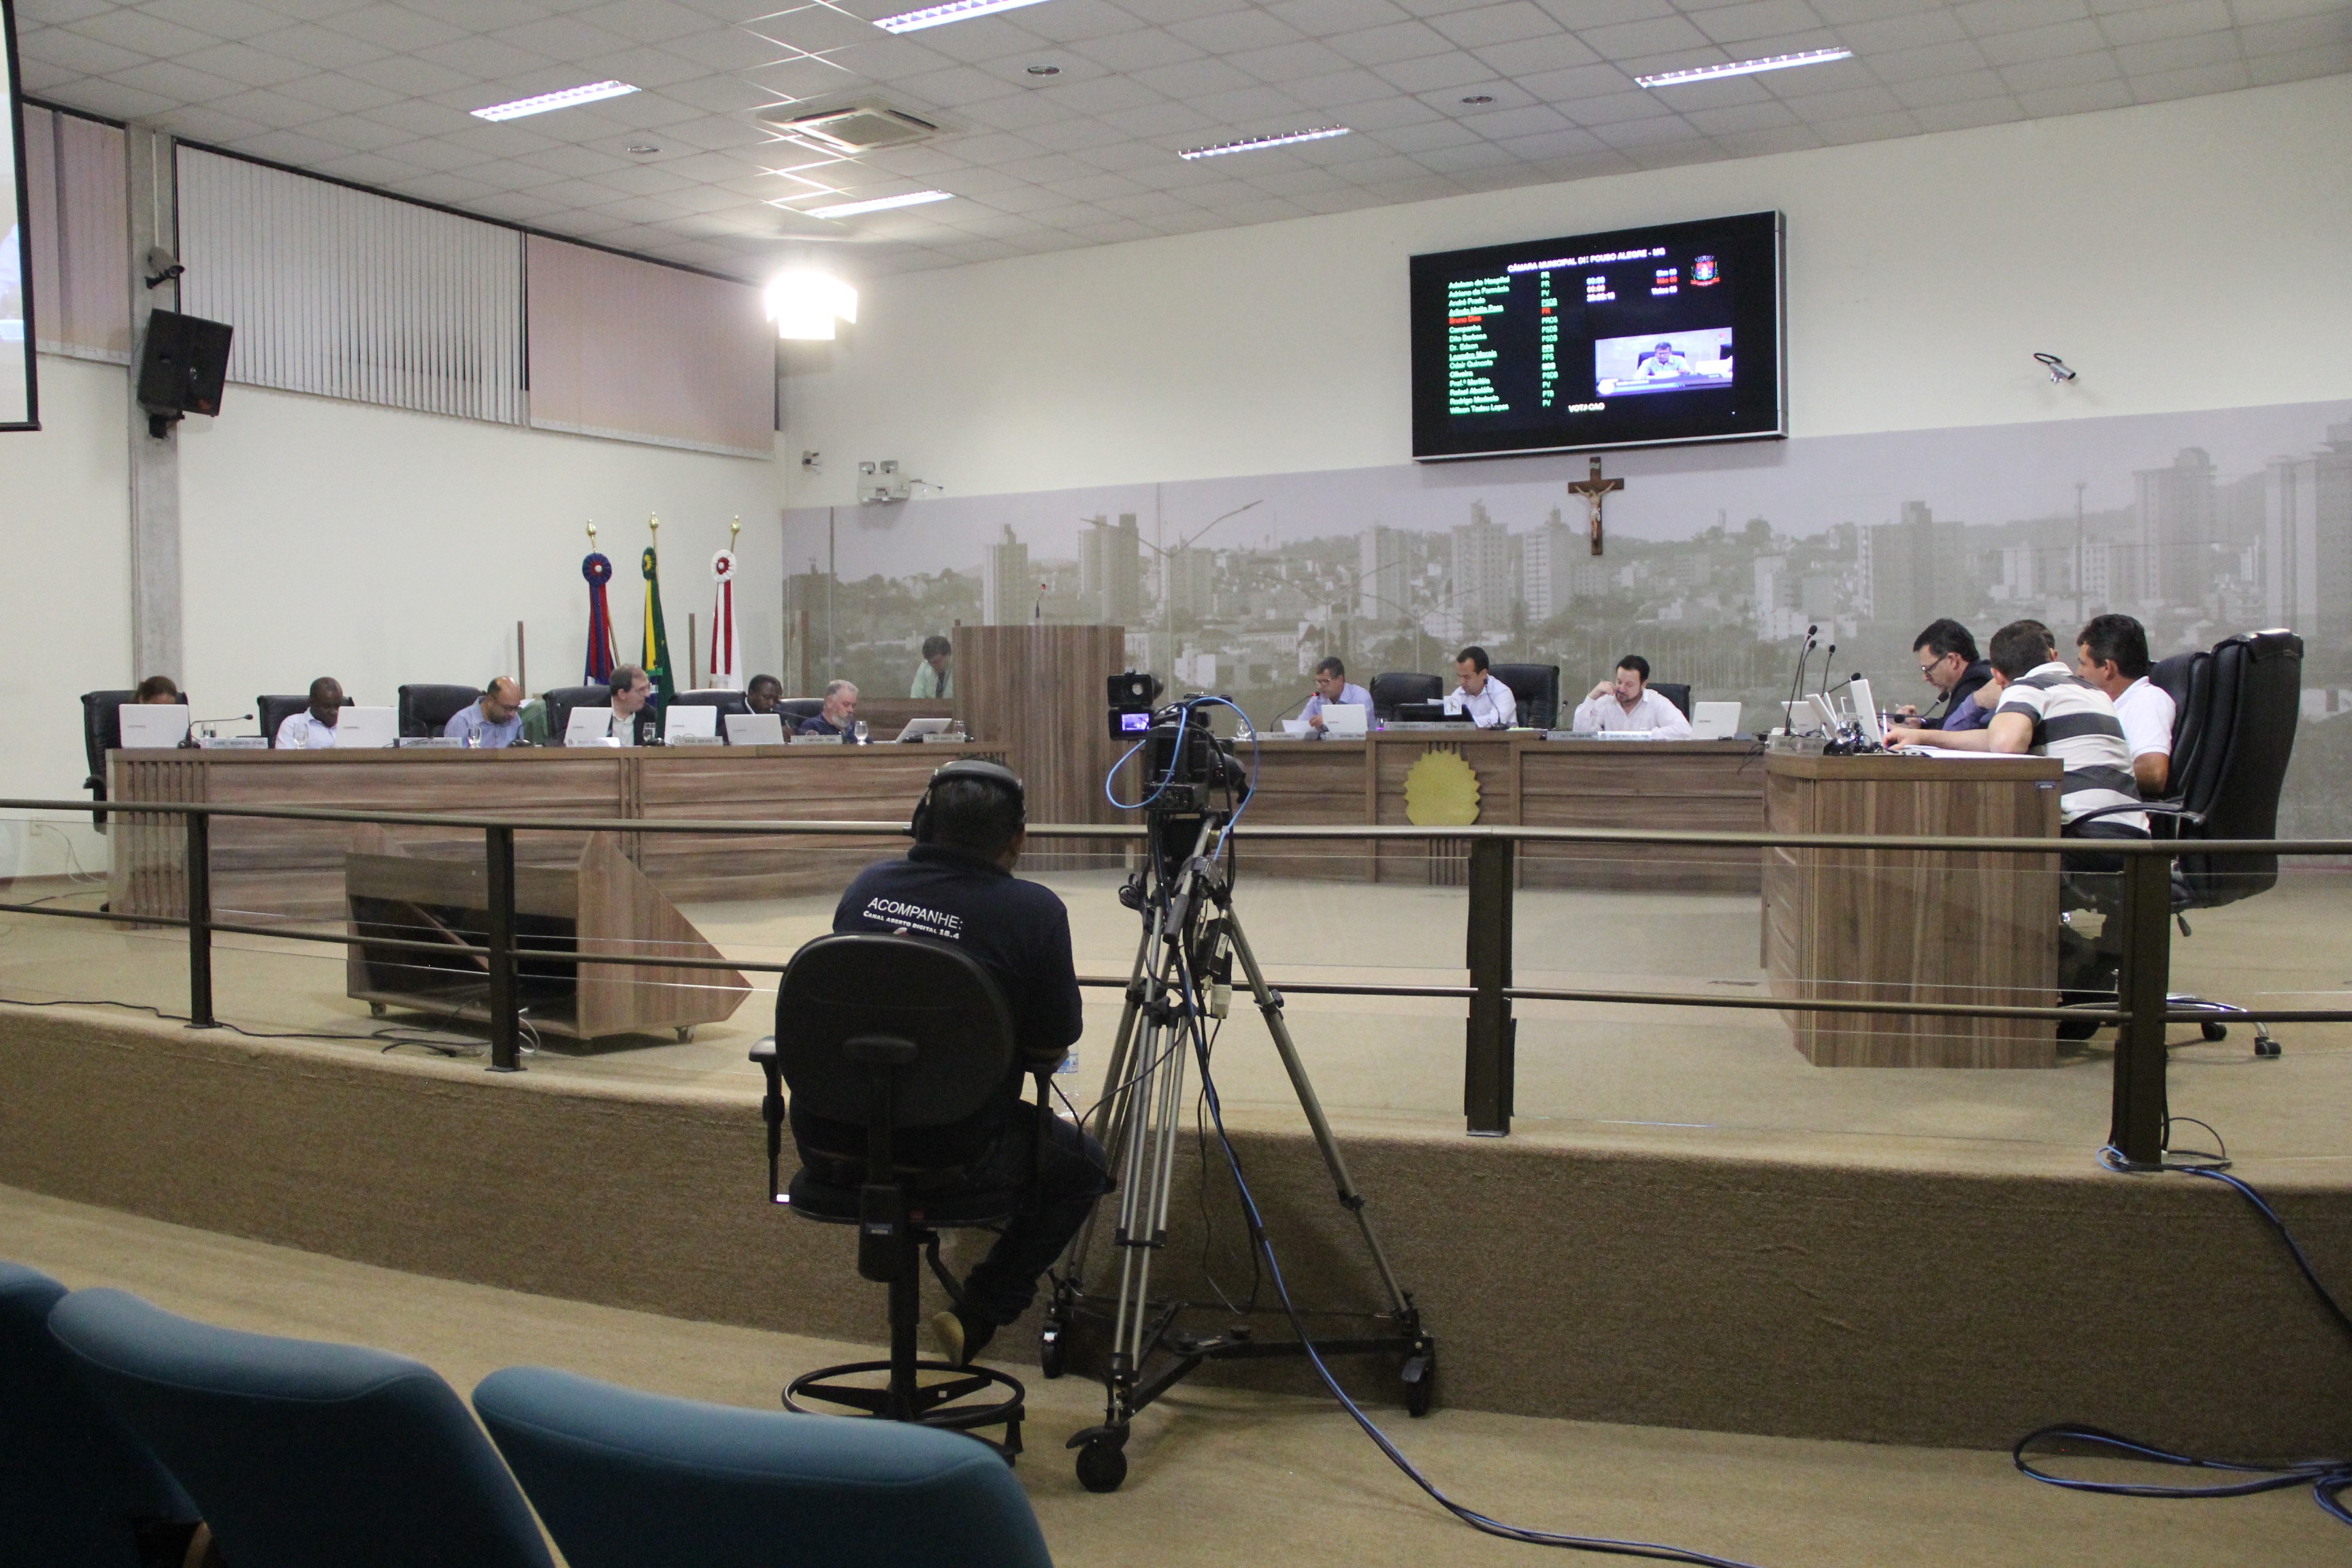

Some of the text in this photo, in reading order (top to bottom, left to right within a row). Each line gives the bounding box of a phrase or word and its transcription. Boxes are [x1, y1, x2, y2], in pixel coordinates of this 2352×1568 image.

[1590, 252, 1617, 263] POUSO
[1617, 249, 1648, 260] ALEGRE
[1652, 247, 1666, 257] MG
[1541, 271, 1550, 279] PR
[1541, 280, 1550, 288] PR
[1541, 297, 1558, 308] PSDB
[1449, 316, 1468, 325] Bruno
[1541, 316, 1558, 325] PROS
[1449, 325, 1482, 334] Campanha
[1541, 325, 1558, 334] PSDB
[1449, 333, 1488, 343] Dito Barbosa
[1541, 334, 1558, 343] PSDB
[1449, 342, 1479, 352] Dr. Edson
[1542, 353, 1555, 361] PPS
[1542, 370, 1558, 380] PSDB
[1542, 380, 1551, 389] PV
[1542, 389, 1555, 398] PTB
[1450, 397, 1473, 406] Rodrigo
[1542, 399, 1552, 407] PV
[886, 917, 911, 928] ABERTO
[912, 923, 937, 934] DIGITAL
